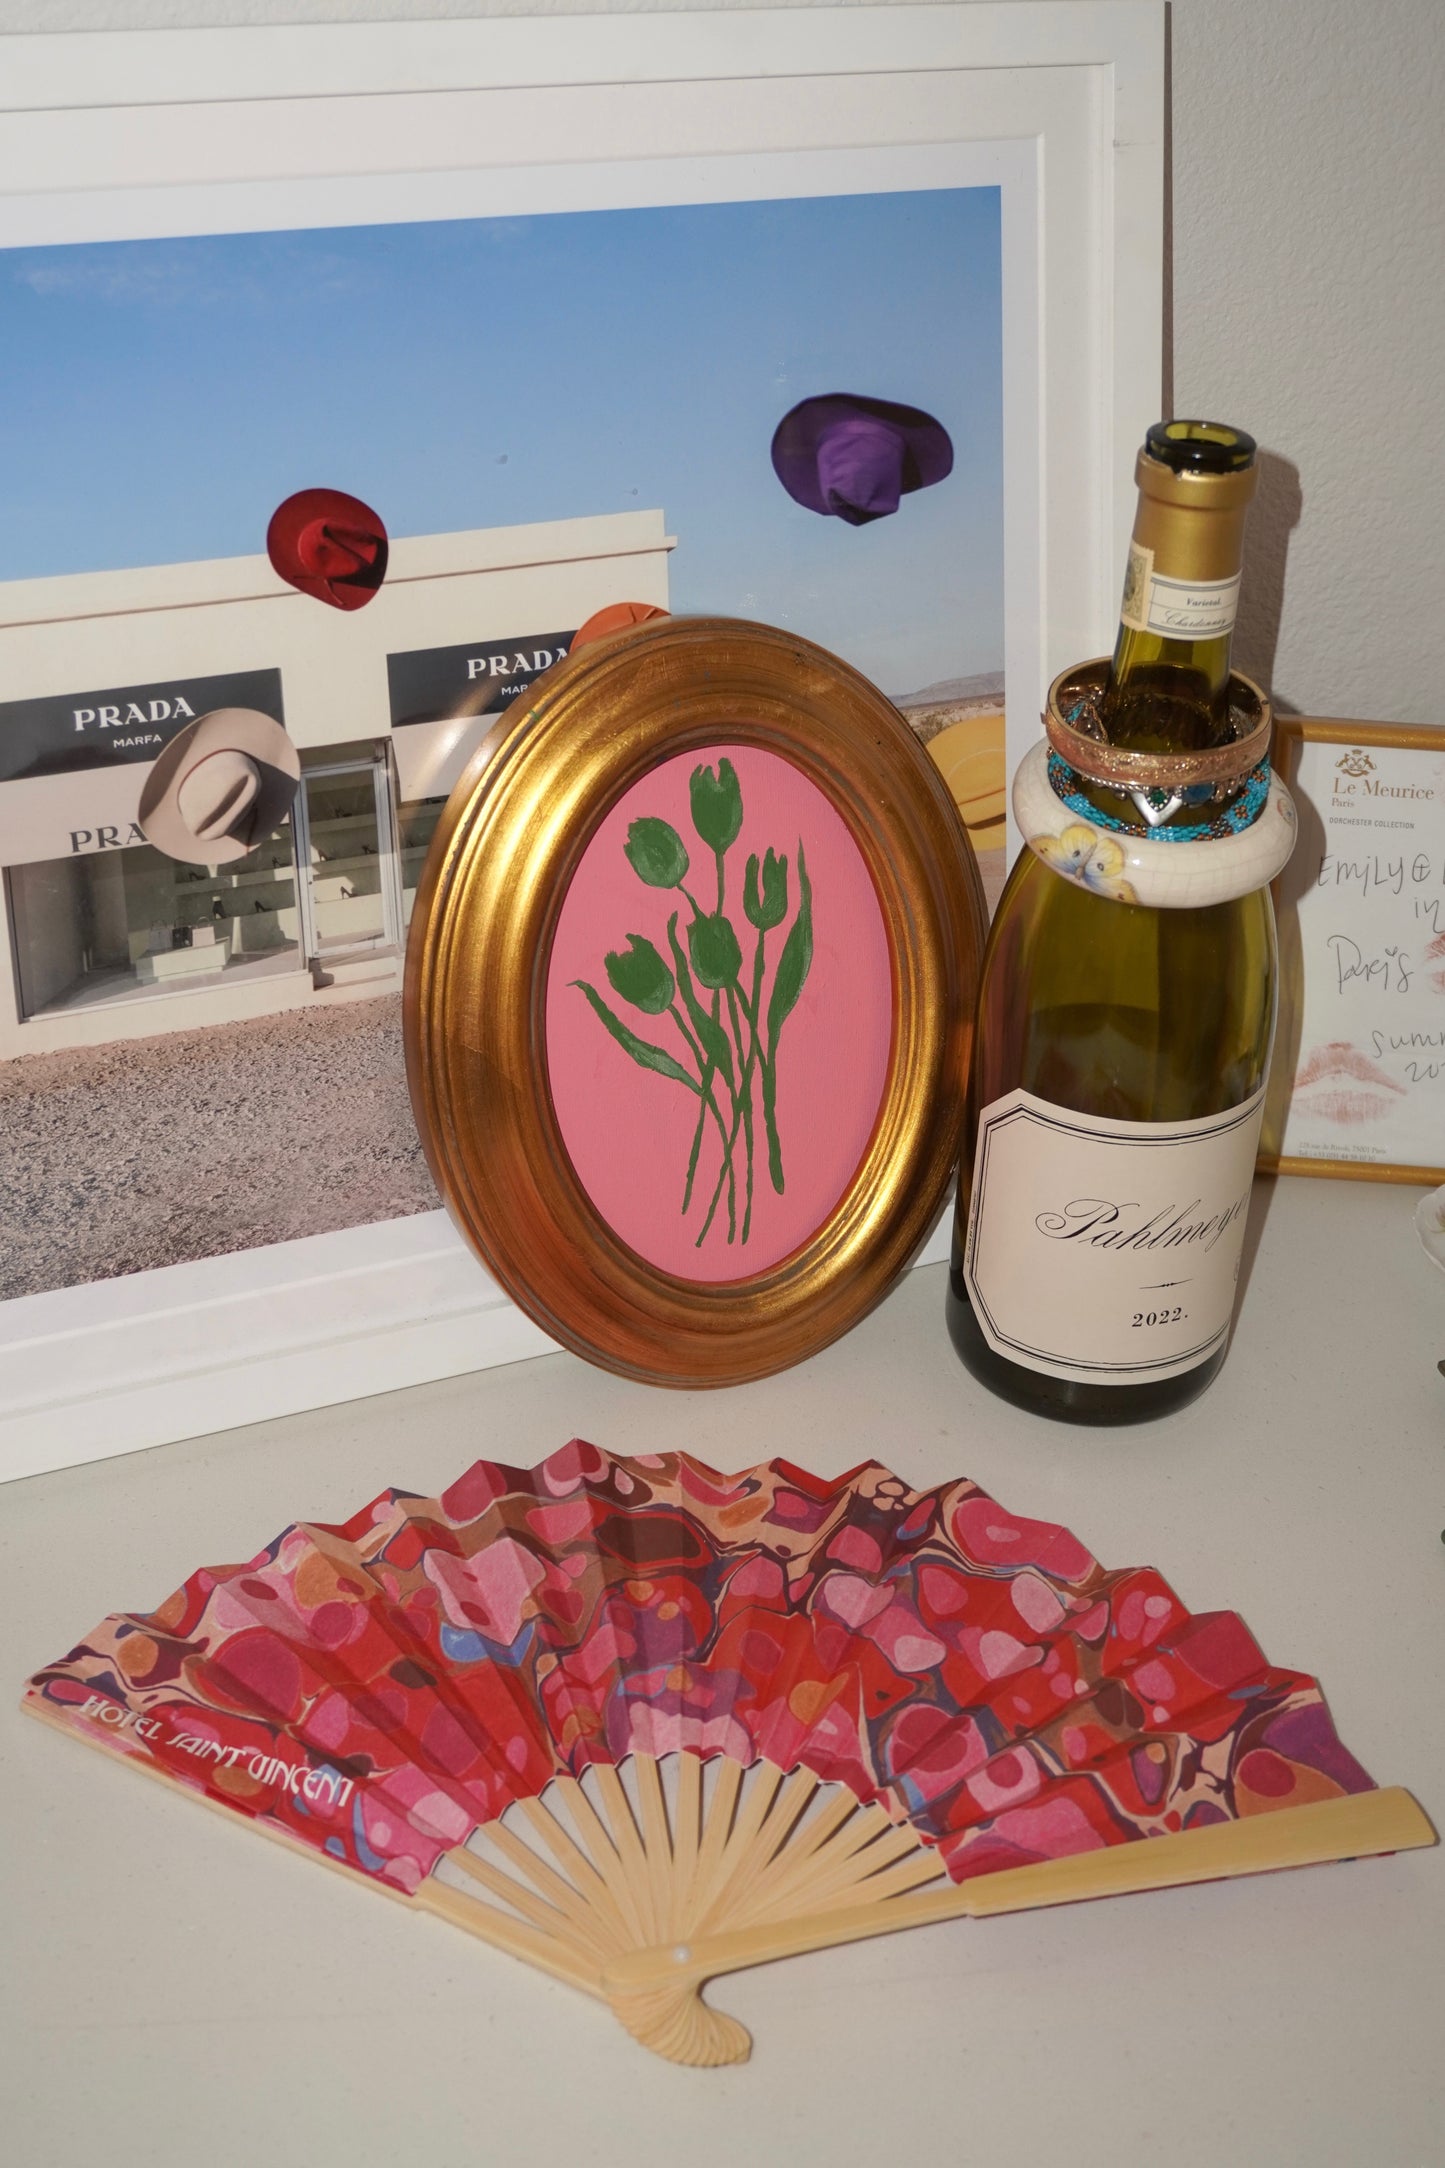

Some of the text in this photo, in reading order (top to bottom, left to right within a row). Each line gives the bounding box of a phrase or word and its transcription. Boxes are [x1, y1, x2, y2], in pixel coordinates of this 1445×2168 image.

[73, 697, 195, 731] PRADA
[113, 734, 162, 748] MARFA
[1331, 797, 1355, 808] Paris
[1333, 777, 1435, 801] Le Meurice
[1329, 817, 1415, 830] DORCHESTER COLLECTION
[69, 822, 150, 853] PRA
[1327, 934, 1415, 995] Paris
[79, 1695, 354, 1807] HOTEL SAINT VINCENT
